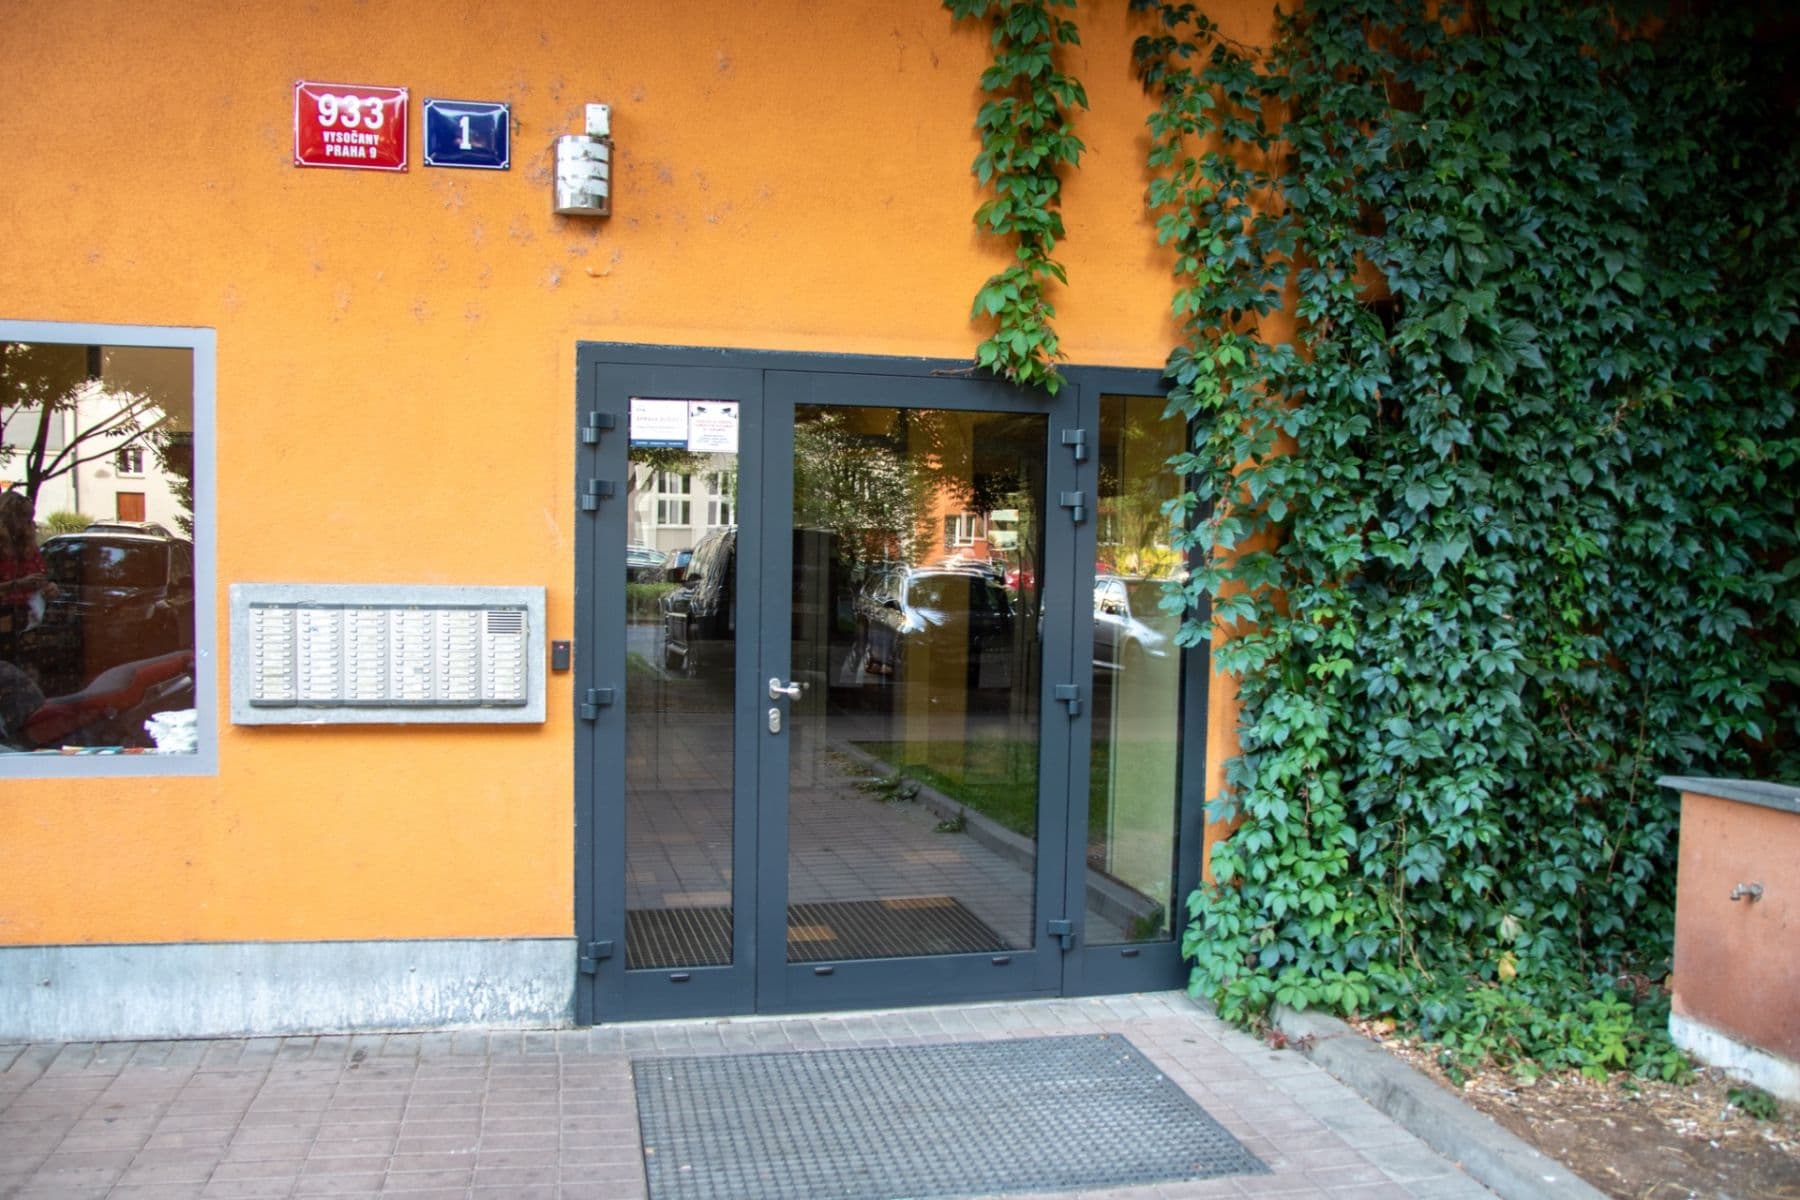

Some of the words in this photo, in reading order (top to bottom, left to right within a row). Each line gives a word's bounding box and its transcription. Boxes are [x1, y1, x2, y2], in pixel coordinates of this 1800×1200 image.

[318, 93, 384, 129] 933
[322, 129, 380, 145] VYSOČANY
[459, 116, 472, 150] 1
[325, 144, 366, 159] PRAHA
[369, 147, 378, 159] 9
